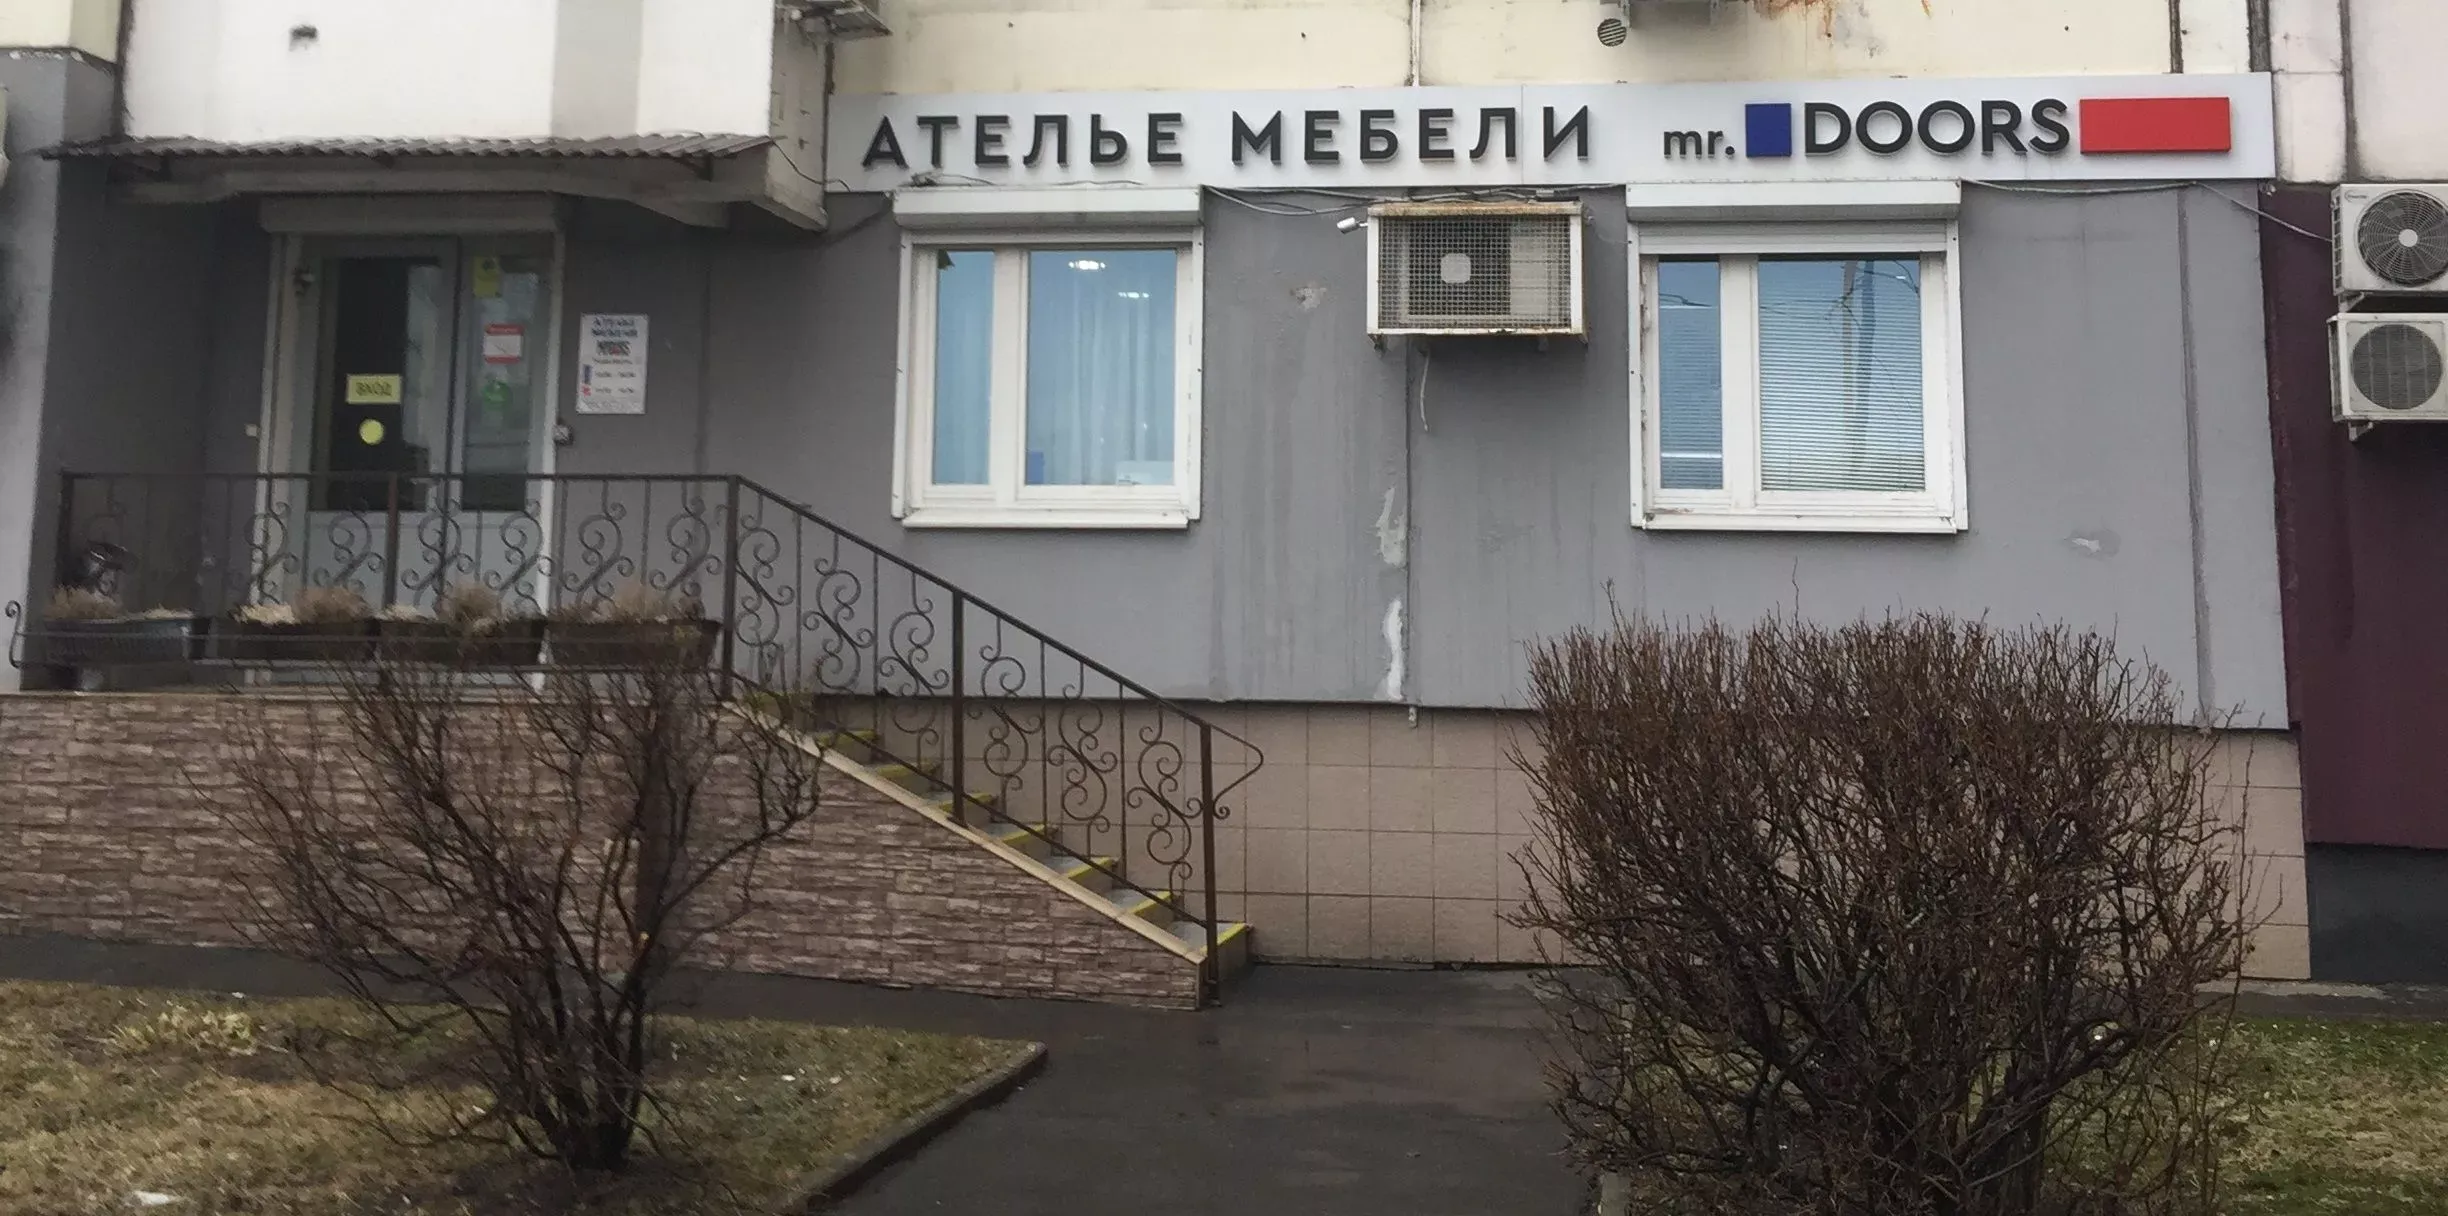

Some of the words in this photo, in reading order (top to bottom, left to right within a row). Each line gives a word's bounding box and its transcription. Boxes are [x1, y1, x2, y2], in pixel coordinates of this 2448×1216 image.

[862, 113, 1185, 168] АТЕЛЬЕ
[1231, 104, 1590, 166] МЕБЕЛИ
[1663, 129, 1736, 159] mr.
[1804, 98, 2071, 156] DOORS
